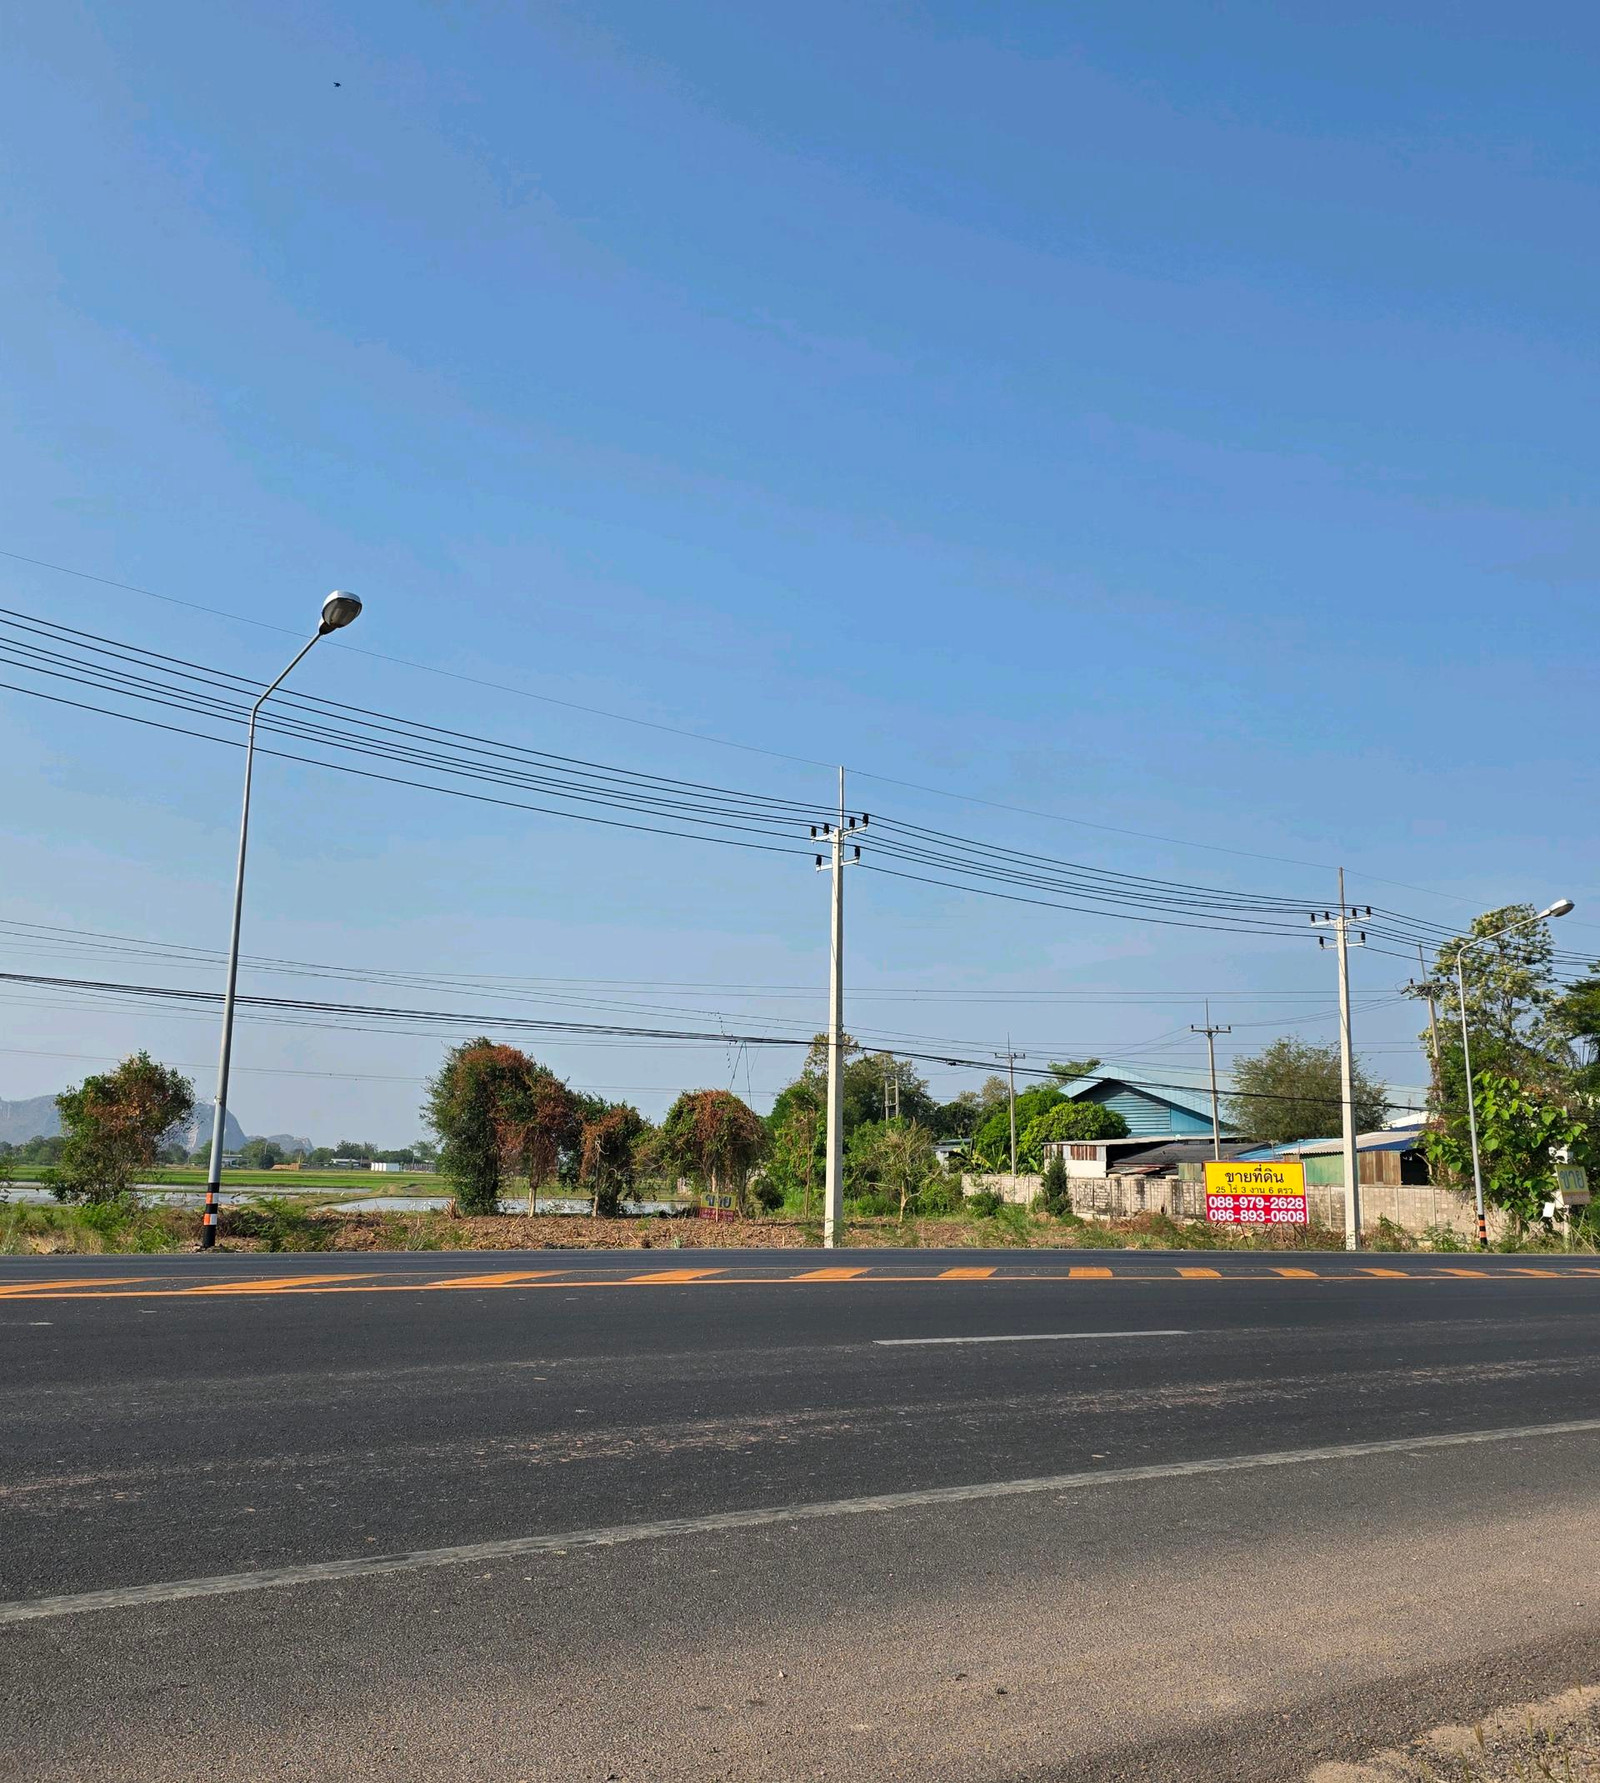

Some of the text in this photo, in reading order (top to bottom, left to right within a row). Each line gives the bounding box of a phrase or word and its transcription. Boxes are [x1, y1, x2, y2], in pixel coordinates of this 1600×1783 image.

[1225, 1164, 1284, 1183] ขายที่ดิน
[1559, 1170, 1585, 1189] ขาย
[1216, 1186, 1226, 1194] 25
[1228, 1184, 1238, 1194] ไร่
[1241, 1186, 1247, 1194] 3
[1208, 1196, 1304, 1209] 088-979-2628
[1209, 1210, 1305, 1222] 086-893-0608
